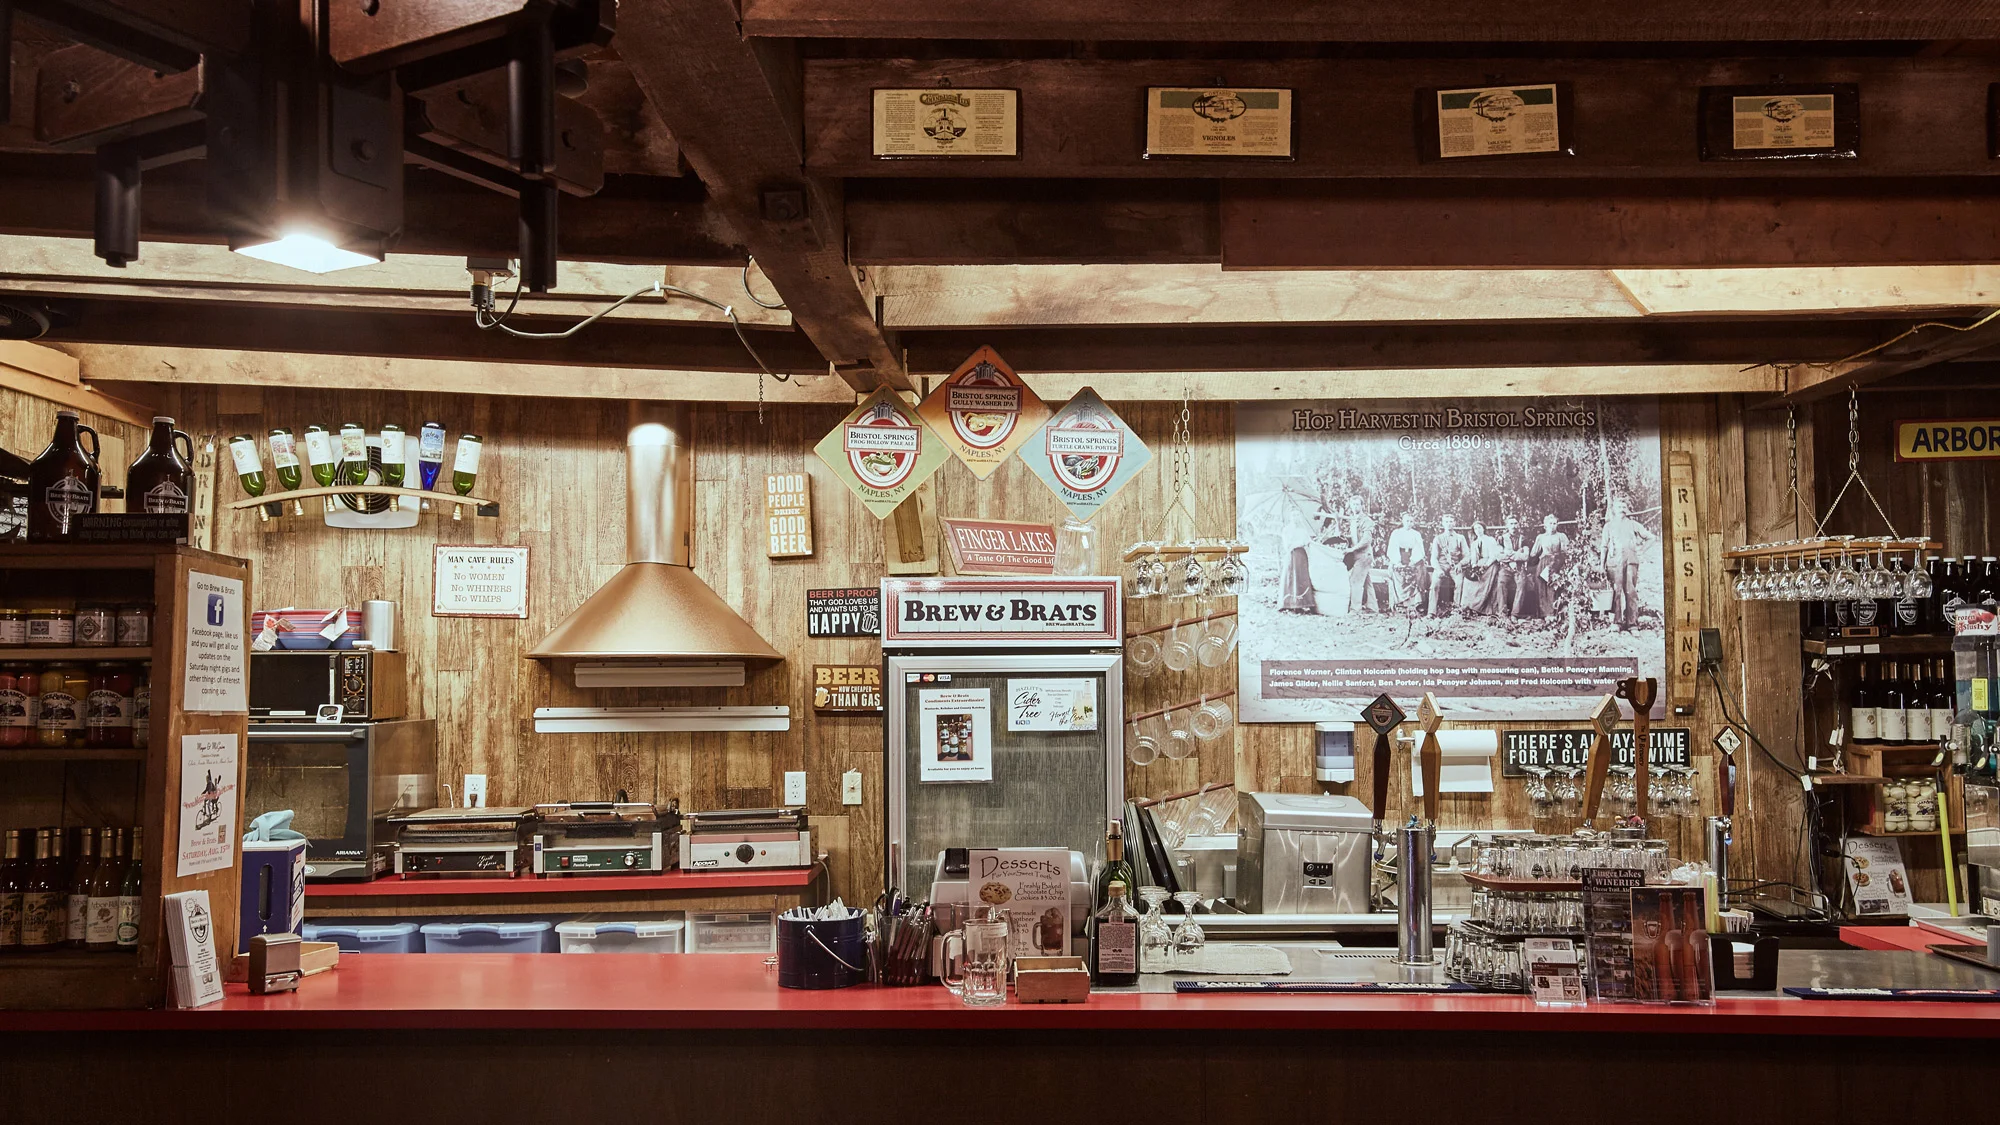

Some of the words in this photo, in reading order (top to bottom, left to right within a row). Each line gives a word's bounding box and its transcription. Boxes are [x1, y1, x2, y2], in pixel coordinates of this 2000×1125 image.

[1293, 409, 1334, 430] HOP
[1338, 409, 1419, 430] HARVEST
[1424, 414, 1441, 429] IN
[1446, 408, 1520, 428] BRISTOL
[1524, 408, 1595, 427] SPRINGS
[1399, 436, 1440, 450] Circa
[1445, 434, 1491, 450] 1880's
[1912, 426, 2000, 452] ARBOR
[960, 445, 994, 458] NAPLES,
[995, 445, 1006, 455] NY
[768, 475, 803, 493] GOOD
[858, 485, 893, 498] NAPLES,
[895, 484, 905, 495] NY
[1061, 487, 1095, 500] NAPLES,
[1097, 487, 1108, 497] NY
[768, 494, 805, 507] PEOPLE
[770, 516, 805, 534] GOOD
[771, 534, 806, 553] BEER
[956, 528, 1010, 551] FINGER
[1008, 531, 1055, 553] LAKES
[967, 553, 972, 561] A
[974, 554, 994, 562] Taste
[996, 554, 1005, 563] Of
[1008, 555, 1021, 563] The
[1023, 556, 1042, 564] Good
[1044, 557, 1055, 565] Lif
[197, 582, 203, 590] Go
[204, 583, 209, 591] to
[210, 584, 220, 592] Brew
[225, 586, 235, 595] Brats
[1678, 488, 1694, 677] RIESLING
[810, 590, 834, 598] BEER
[836, 590, 844, 598] IS
[847, 589, 878, 597] PROOF
[904, 600, 983, 622] BREW
[985, 604, 1005, 621] &
[1010, 599, 1097, 621] BRATS
[810, 613, 860, 634] HAPPY
[192, 627, 212, 636] Facebook
[213, 631, 223, 639] page,
[199, 653, 216, 661] updates
[190, 662, 208, 672] Saturday
[210, 665, 221, 673] night
[222, 666, 230, 674] gigs
[1304, 668, 1333, 676] Worner,
[1599, 666, 1634, 674] Manning,
[202, 676, 216, 684] things
[816, 668, 880, 685] BEER
[1296, 680, 1320, 688] Gilder,
[202, 687, 219, 695] coming
[832, 694, 858, 706] THAN
[861, 694, 881, 706] GAS
[1014, 692, 1041, 705] Cider
[1014, 704, 1041, 719] Tree
[1508, 733, 1573, 749] THERE'S
[1580, 733, 1635, 749] AAY
[1650, 732, 1685, 748] TIME
[1509, 749, 1538, 764] FOR
[1546, 749, 1555, 764] A
[1562, 748, 1589, 764] GLA
[1648, 748, 1685, 763] WINE
[182, 850, 208, 860] SATURDAY,
[208, 847, 219, 856] AUG.
[1847, 841, 1894, 854] Desserts
[981, 856, 1061, 878] Desserts
[992, 872, 1001, 880] For
[1036, 871, 1052, 880] Tooth
[1592, 870, 1617, 878] Finger
[1620, 870, 1641, 878] Lakes
[1020, 882, 1040, 890] Freshly
